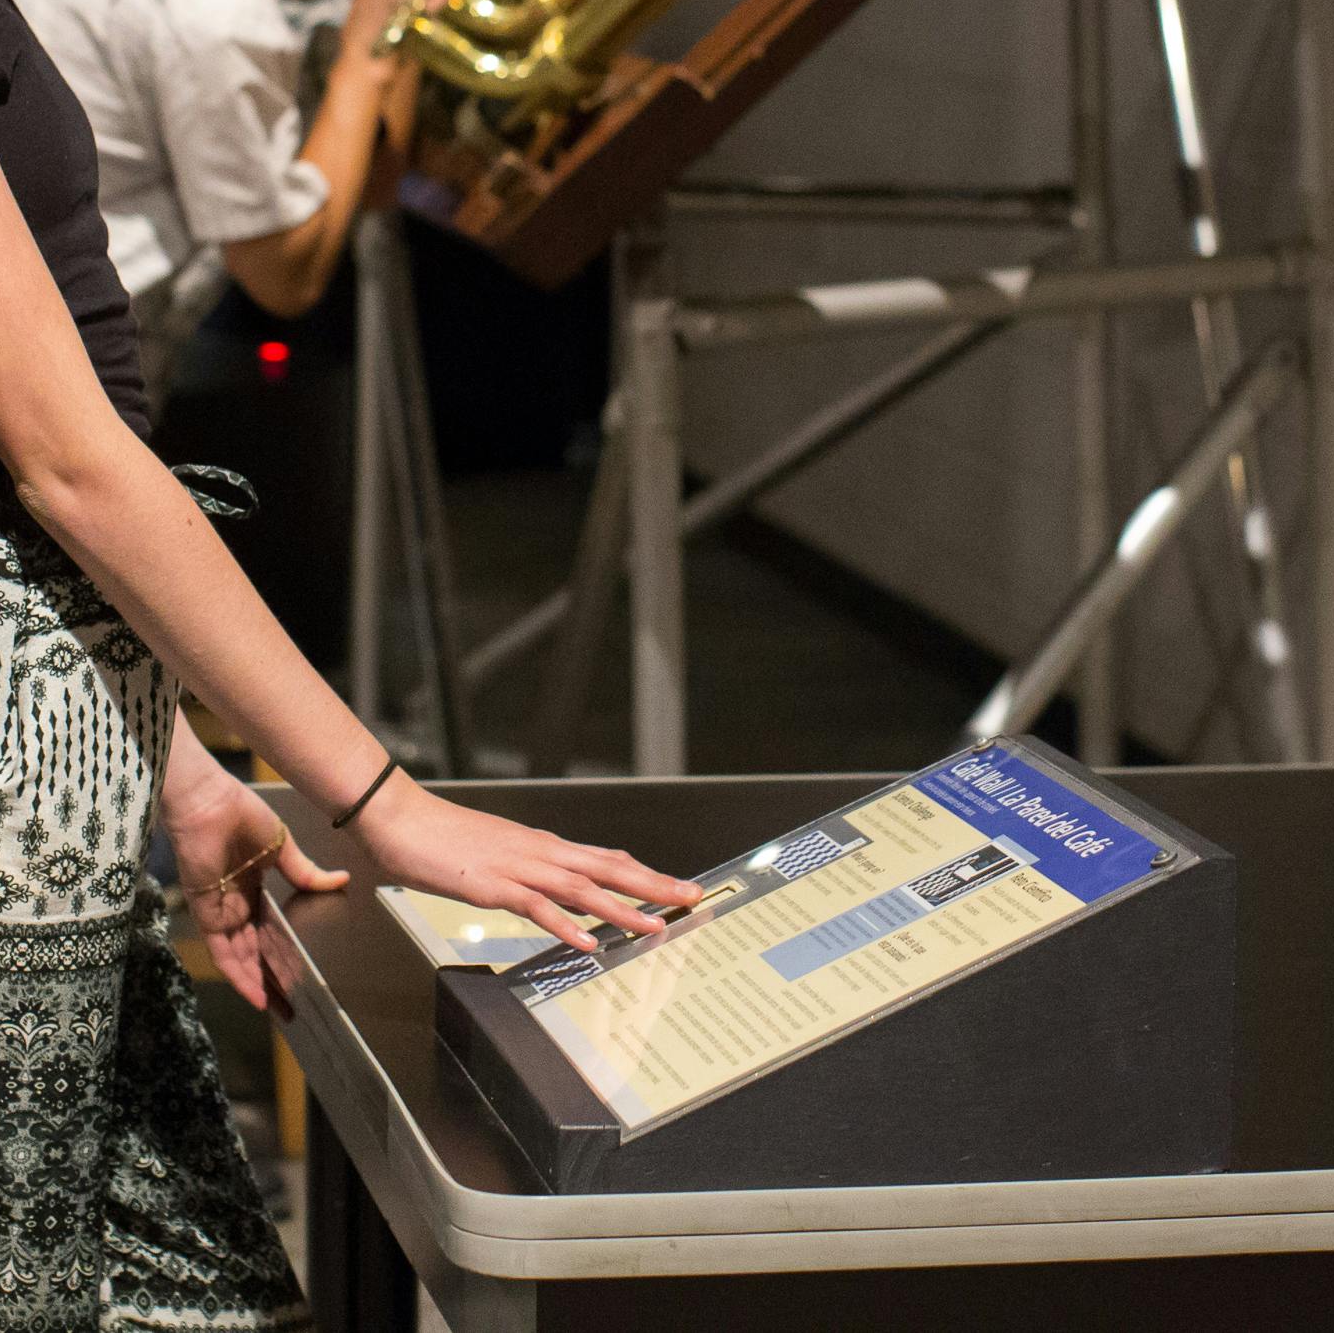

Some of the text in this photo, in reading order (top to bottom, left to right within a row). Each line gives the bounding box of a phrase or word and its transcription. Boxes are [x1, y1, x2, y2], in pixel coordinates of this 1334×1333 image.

[971, 769, 1017, 795] Wall
[996, 787, 1027, 807] La
[1010, 796, 1069, 828] Pared
[1043, 818, 1088, 840] del
[1063, 830, 1114, 858] Café
